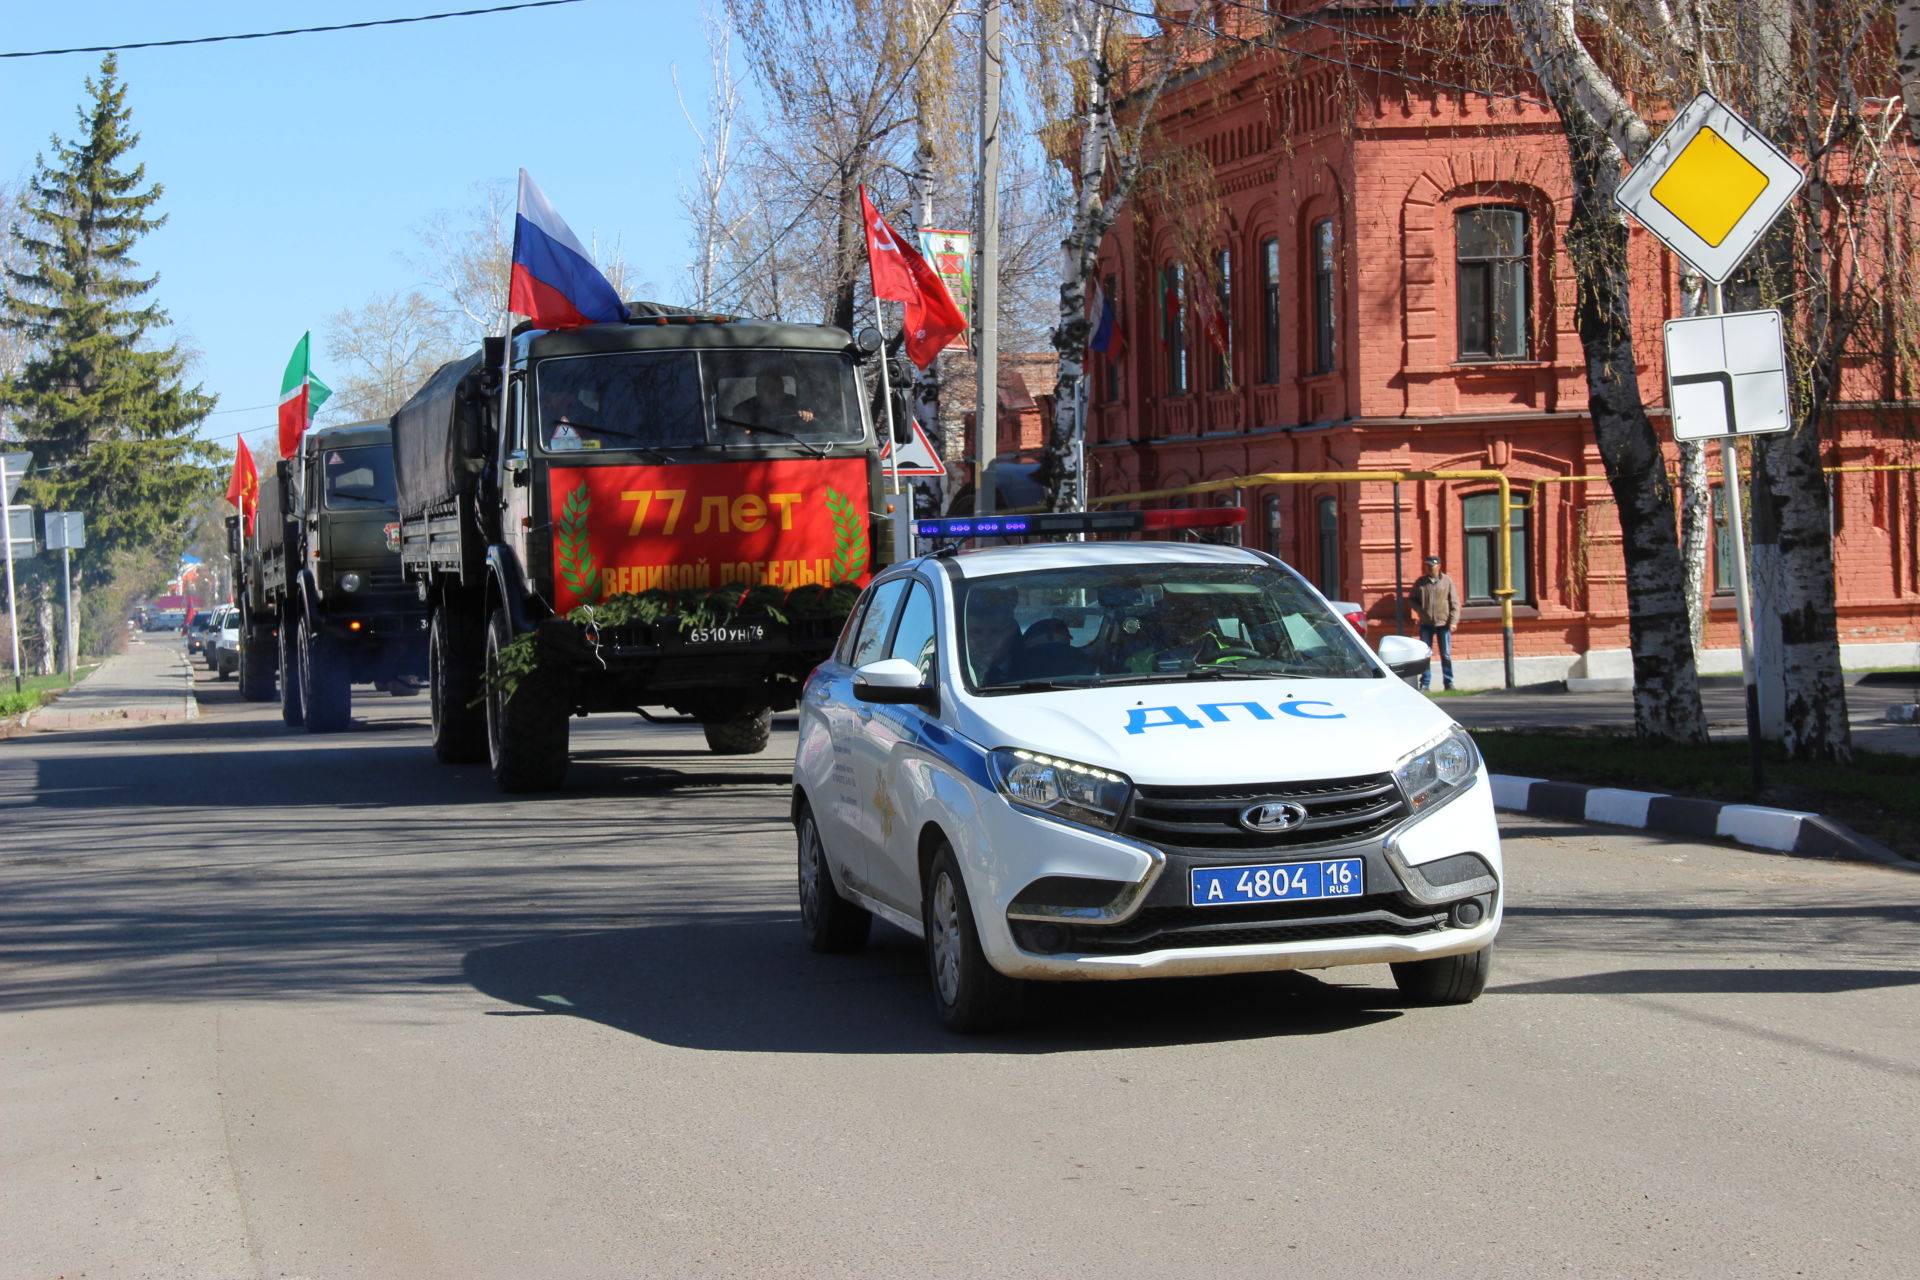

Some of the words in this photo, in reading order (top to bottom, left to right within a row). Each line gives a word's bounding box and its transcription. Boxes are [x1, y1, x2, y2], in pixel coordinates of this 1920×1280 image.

[621, 490, 687, 536] 77
[694, 493, 802, 534] лет
[602, 558, 710, 597] ВЕЛИКОЙ
[720, 559, 831, 589] ПОБЕДЫ!
[691, 627, 727, 642] 6510
[729, 629, 746, 641] УН
[750, 626, 764, 637] 76
[1123, 700, 1348, 735] ДПС
[1208, 879, 1223, 900] А
[1236, 868, 1307, 898] 4804
[1326, 863, 1352, 885] 16
[1329, 885, 1349, 894] RUS
